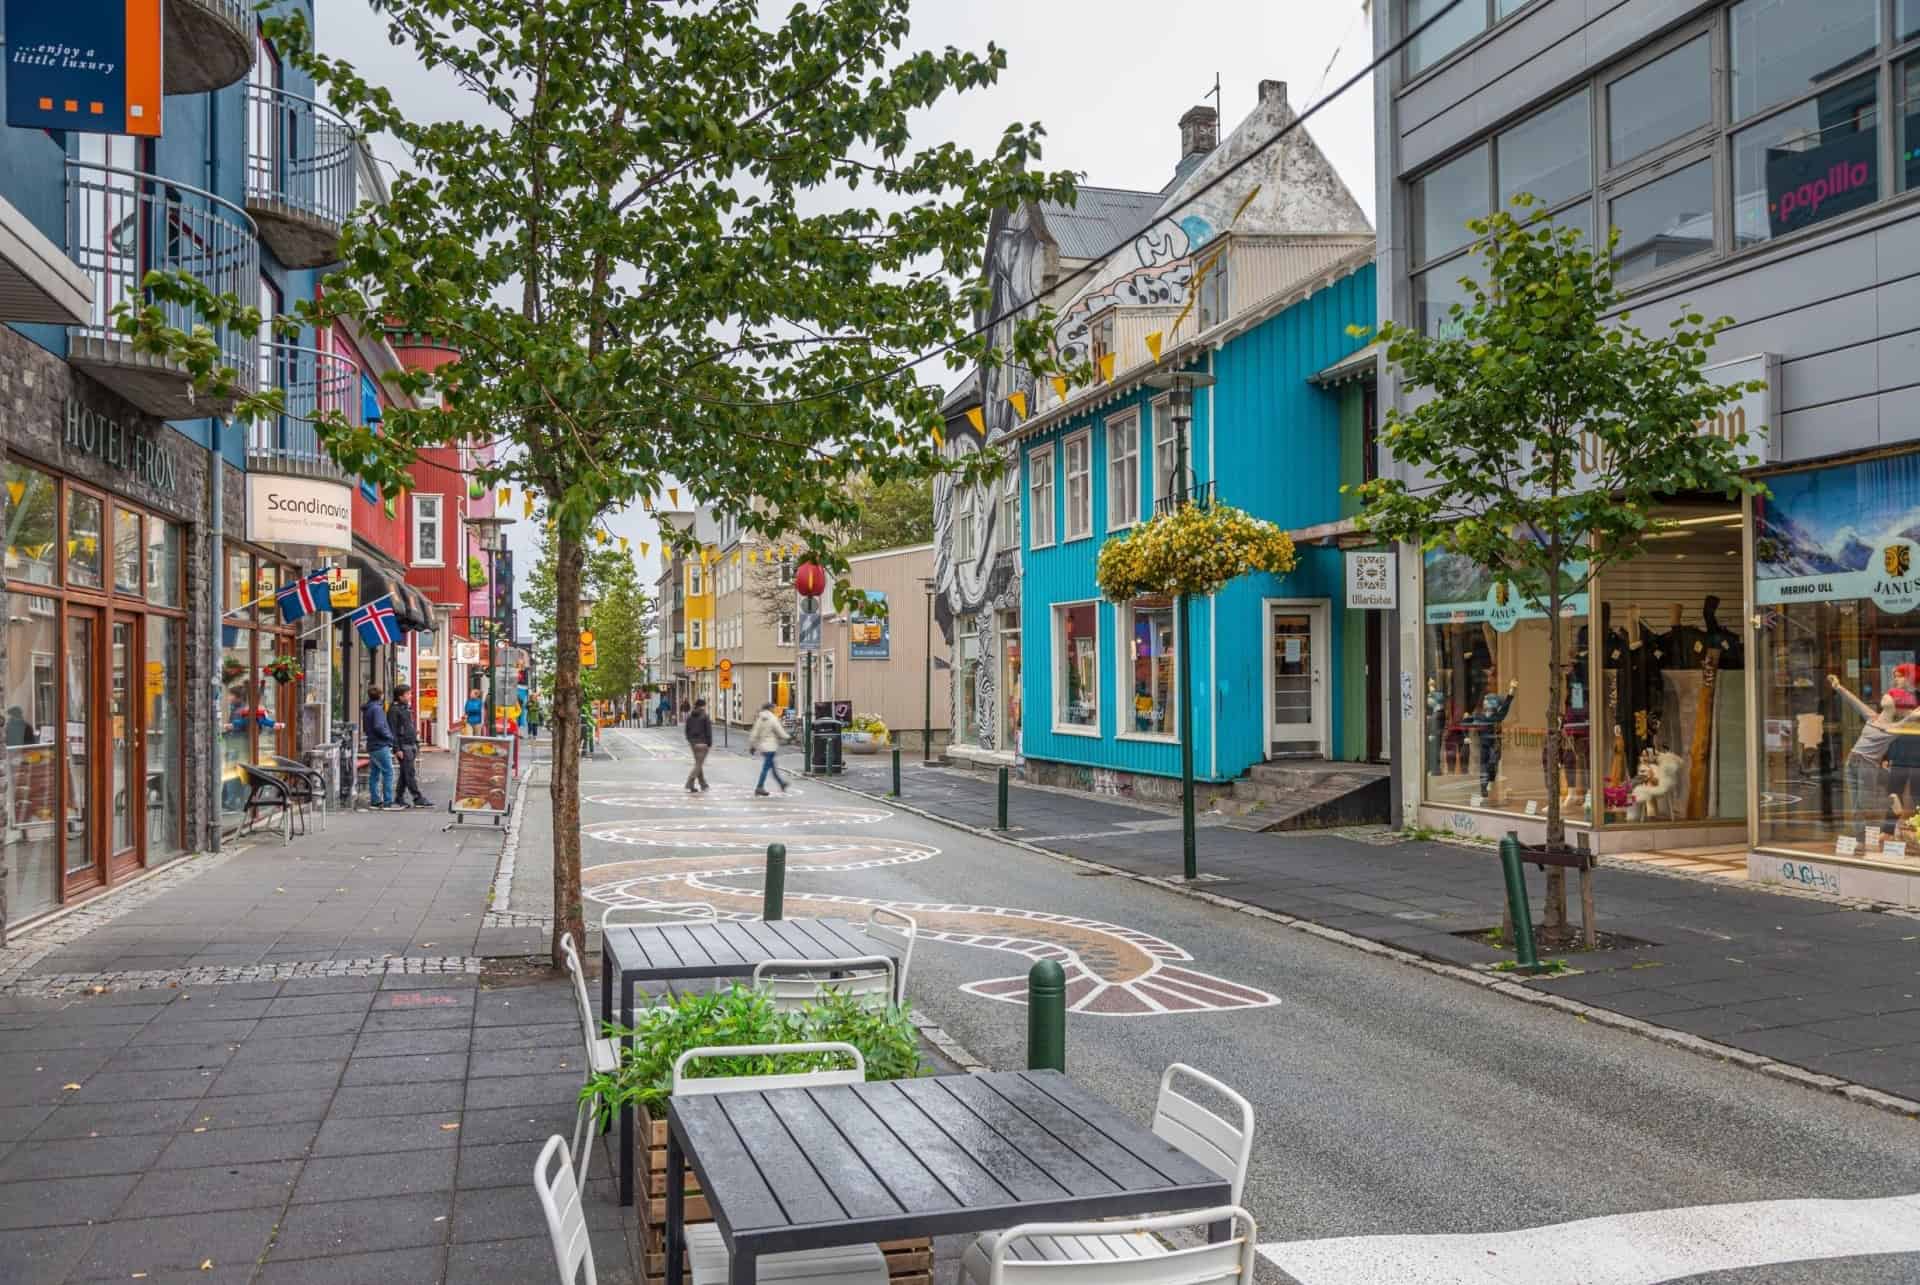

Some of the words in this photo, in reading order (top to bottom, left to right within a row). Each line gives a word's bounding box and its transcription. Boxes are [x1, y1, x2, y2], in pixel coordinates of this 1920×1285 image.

[87, 49, 95, 57] a
[14, 52, 56, 66] little
[62, 57, 115, 74] luxury
[63, 396, 128, 469] HOTEL
[1780, 584, 1816, 596] MERINO
[1817, 583, 1833, 593] ULL
[1873, 577, 1920, 596] JANUS
[1491, 607, 1517, 620] JANUS
